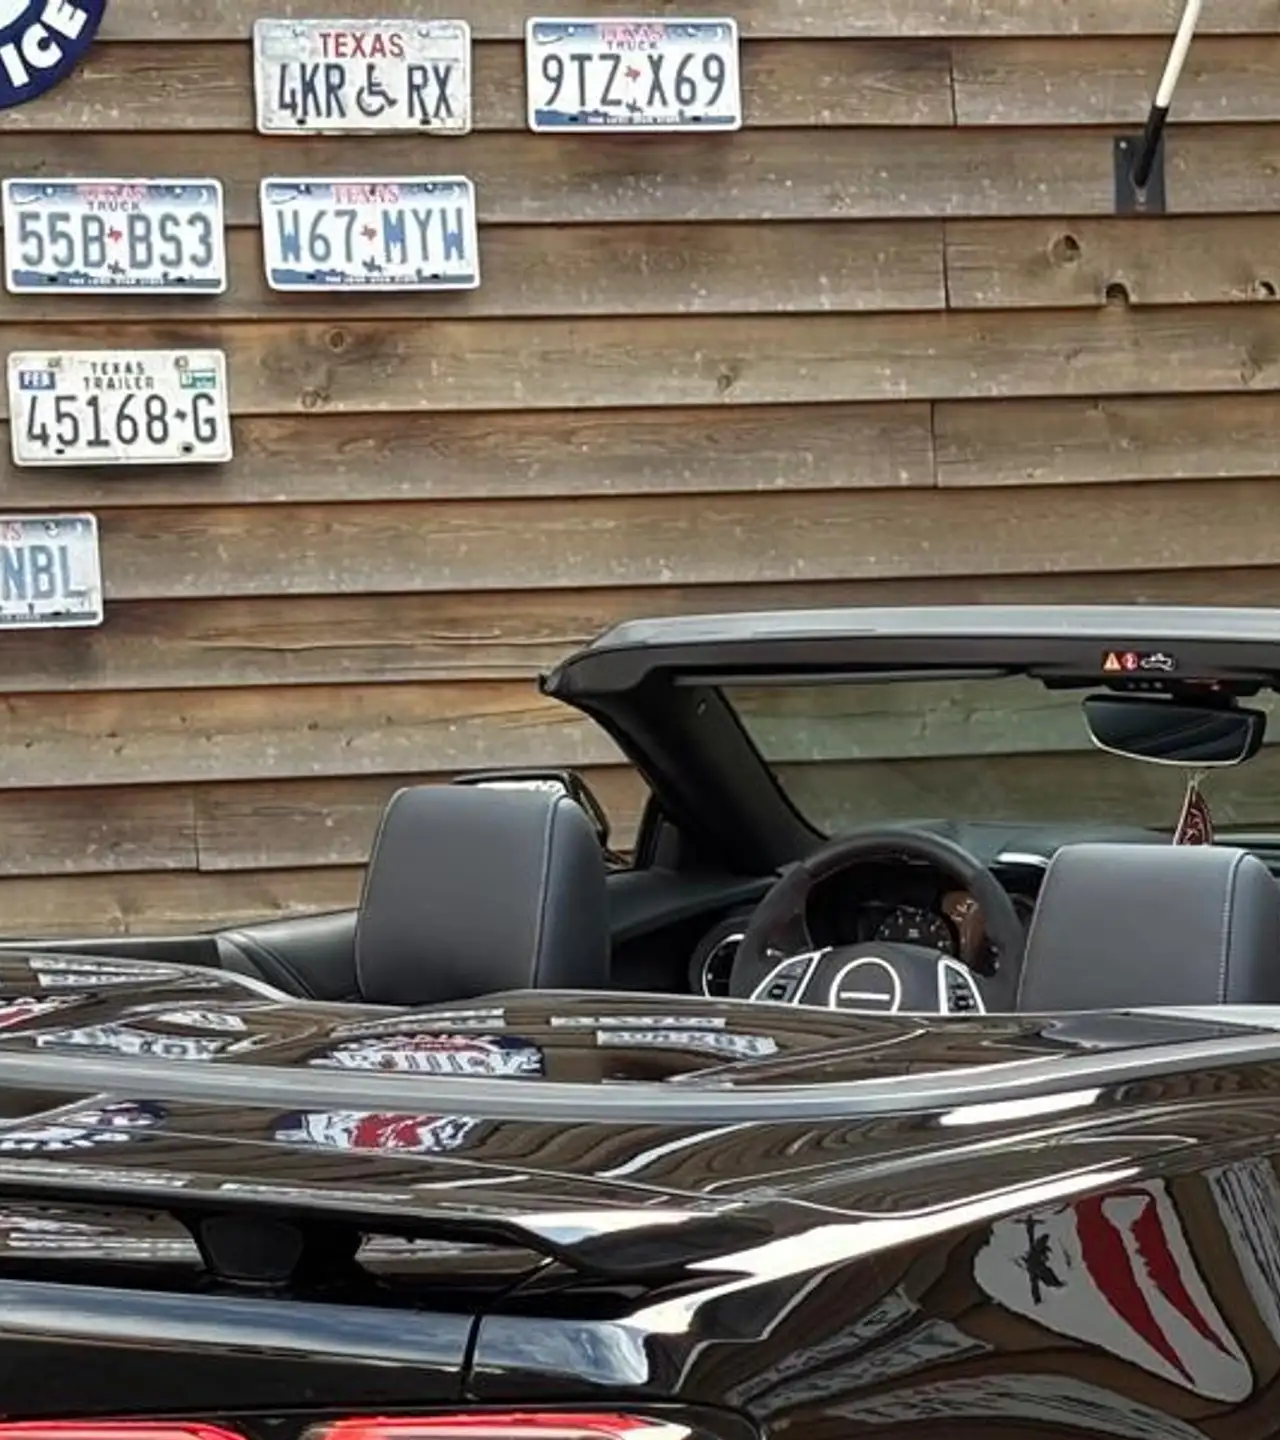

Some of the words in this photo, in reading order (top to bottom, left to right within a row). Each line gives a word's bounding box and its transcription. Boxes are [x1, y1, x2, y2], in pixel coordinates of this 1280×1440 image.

[319, 32, 404, 58] TEXAS
[278, 63, 347, 119] 4KR
[407, 63, 454, 119] RX
[86, 201, 142, 211] TRUCK
[91, 361, 146, 376] TEXAS
[83, 376, 155, 390] TRAILER
[26, 393, 170, 447] 45168
[0, 544, 88, 601] NBL
